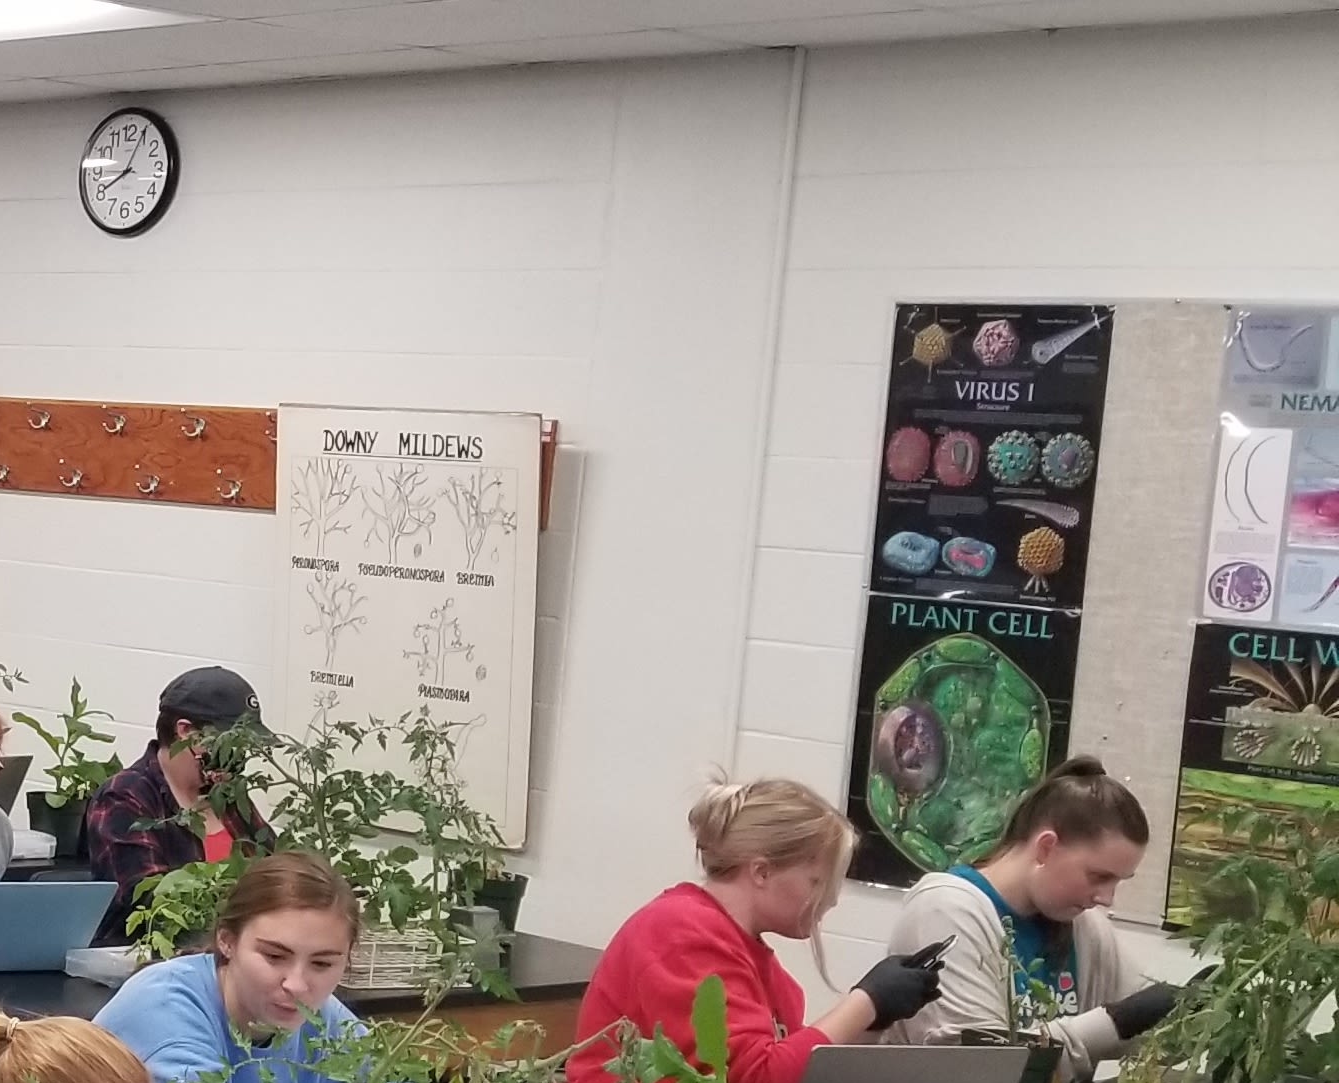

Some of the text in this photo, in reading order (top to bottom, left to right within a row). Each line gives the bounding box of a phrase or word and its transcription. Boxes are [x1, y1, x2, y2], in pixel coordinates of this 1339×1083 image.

[110, 129, 121, 148] 11
[123, 124, 137, 141] 12
[149, 140, 159, 158] 2
[154, 161, 164, 178] 3
[96, 184, 106, 201] 8
[146, 182, 157, 199] 4
[107, 198, 117, 215] 7
[120, 201, 130, 219] 6
[134, 196, 145, 213] 5
[955, 381, 1035, 402] VIRUS I
[323, 429, 483, 459] DOWNY MILDEWS
[891, 601, 1055, 640] PLANT CELL
[1228, 632, 1304, 663] CELL
